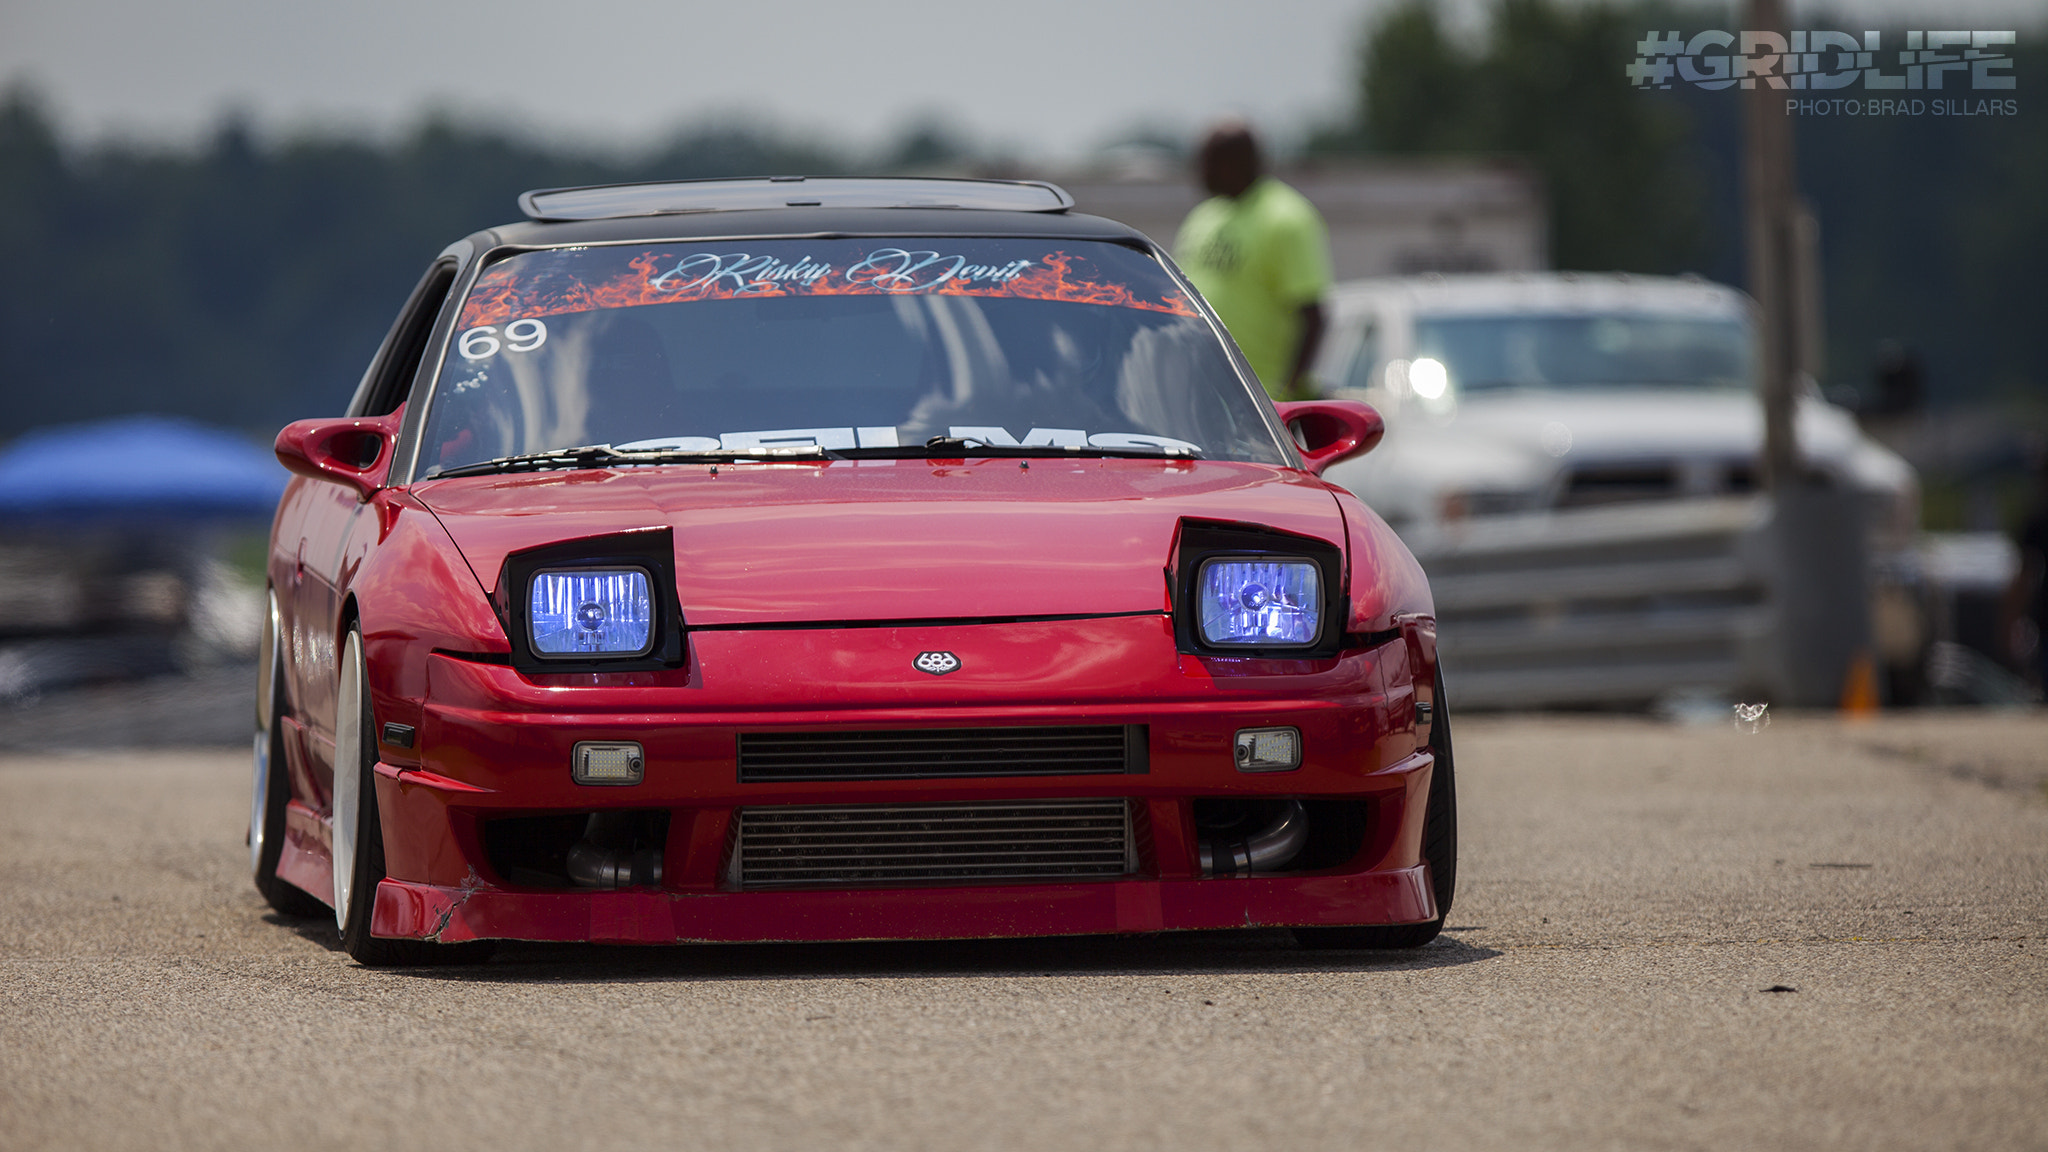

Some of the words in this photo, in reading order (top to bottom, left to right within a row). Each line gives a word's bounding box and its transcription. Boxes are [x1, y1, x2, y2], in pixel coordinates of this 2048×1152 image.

[649, 252, 831, 297] Risky
[845, 247, 1036, 292] Devil
[458, 318, 548, 360] 69
